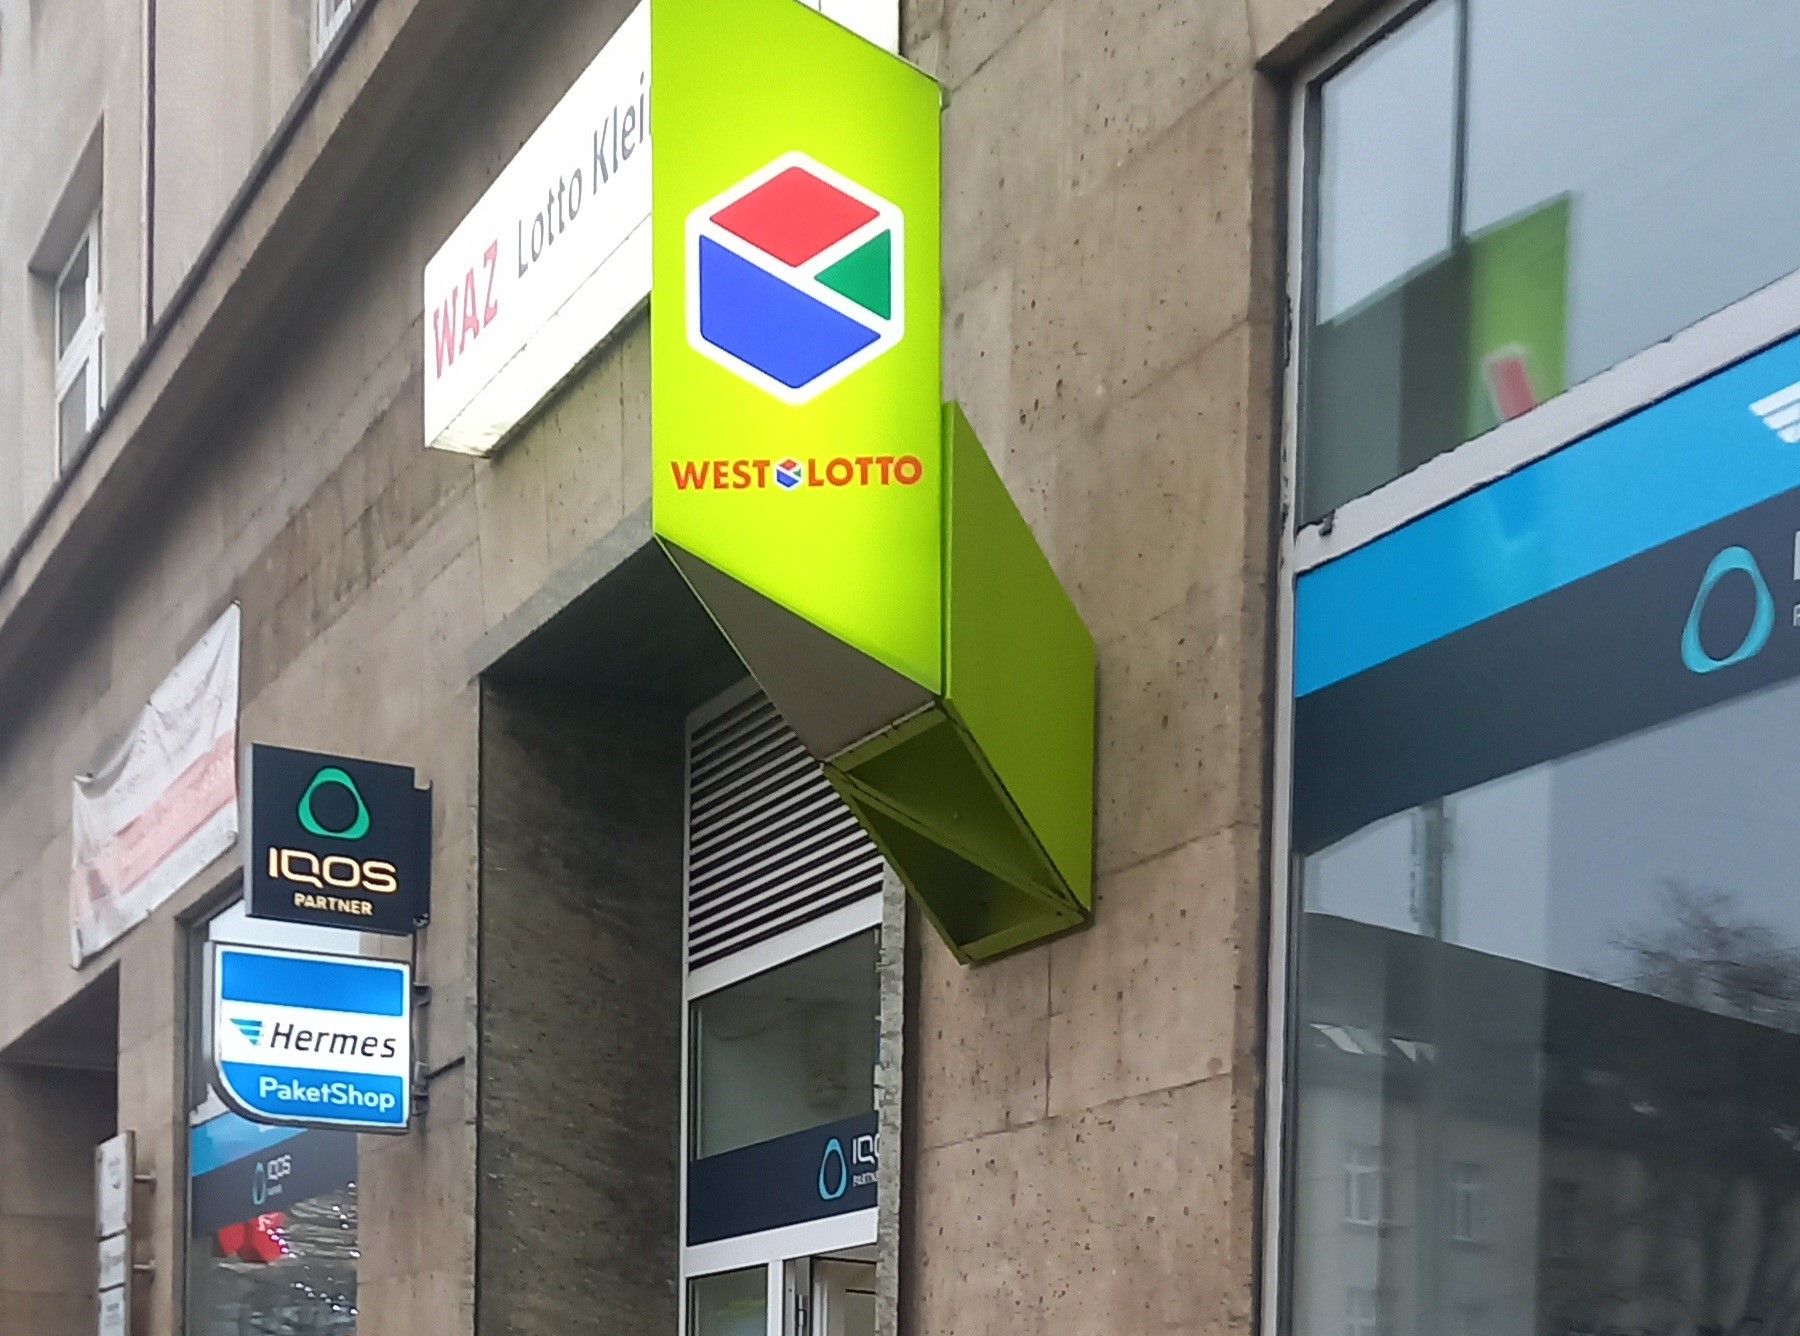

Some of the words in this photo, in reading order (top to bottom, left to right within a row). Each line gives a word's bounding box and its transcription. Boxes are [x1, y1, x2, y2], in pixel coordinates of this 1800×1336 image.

[433, 238, 498, 380] WAZ
[518, 167, 582, 279] Lotto
[593, 70, 652, 196] Klei
[671, 459, 771, 490] WEST
[808, 455, 923, 487] LOTTO
[268, 846, 398, 894] IQOS
[293, 892, 374, 917] PARTNER
[270, 1022, 397, 1058] Hermes
[259, 1075, 396, 1113] PaketShop
